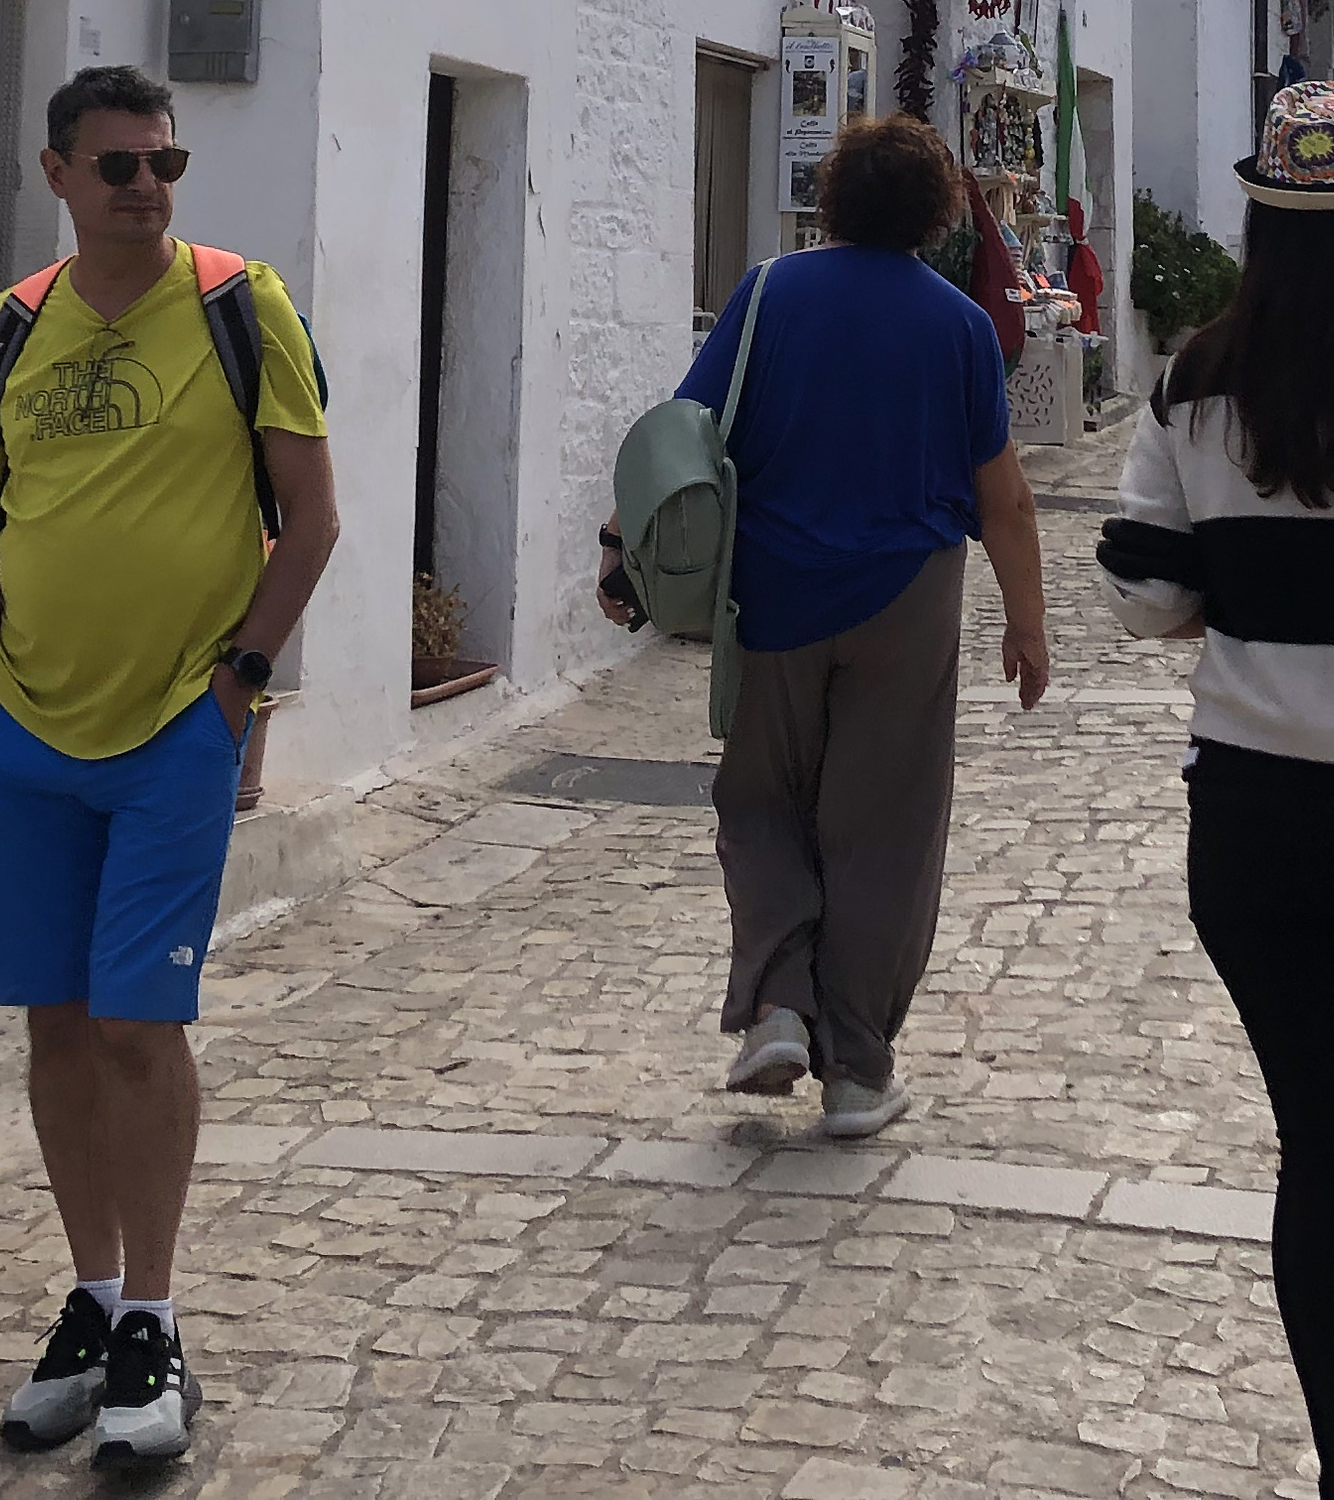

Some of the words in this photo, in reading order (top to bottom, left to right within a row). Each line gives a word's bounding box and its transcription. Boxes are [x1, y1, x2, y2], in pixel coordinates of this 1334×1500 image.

[52, 360, 114, 388] THE
[15, 381, 112, 421] NORTH
[36, 410, 109, 441] FACE
